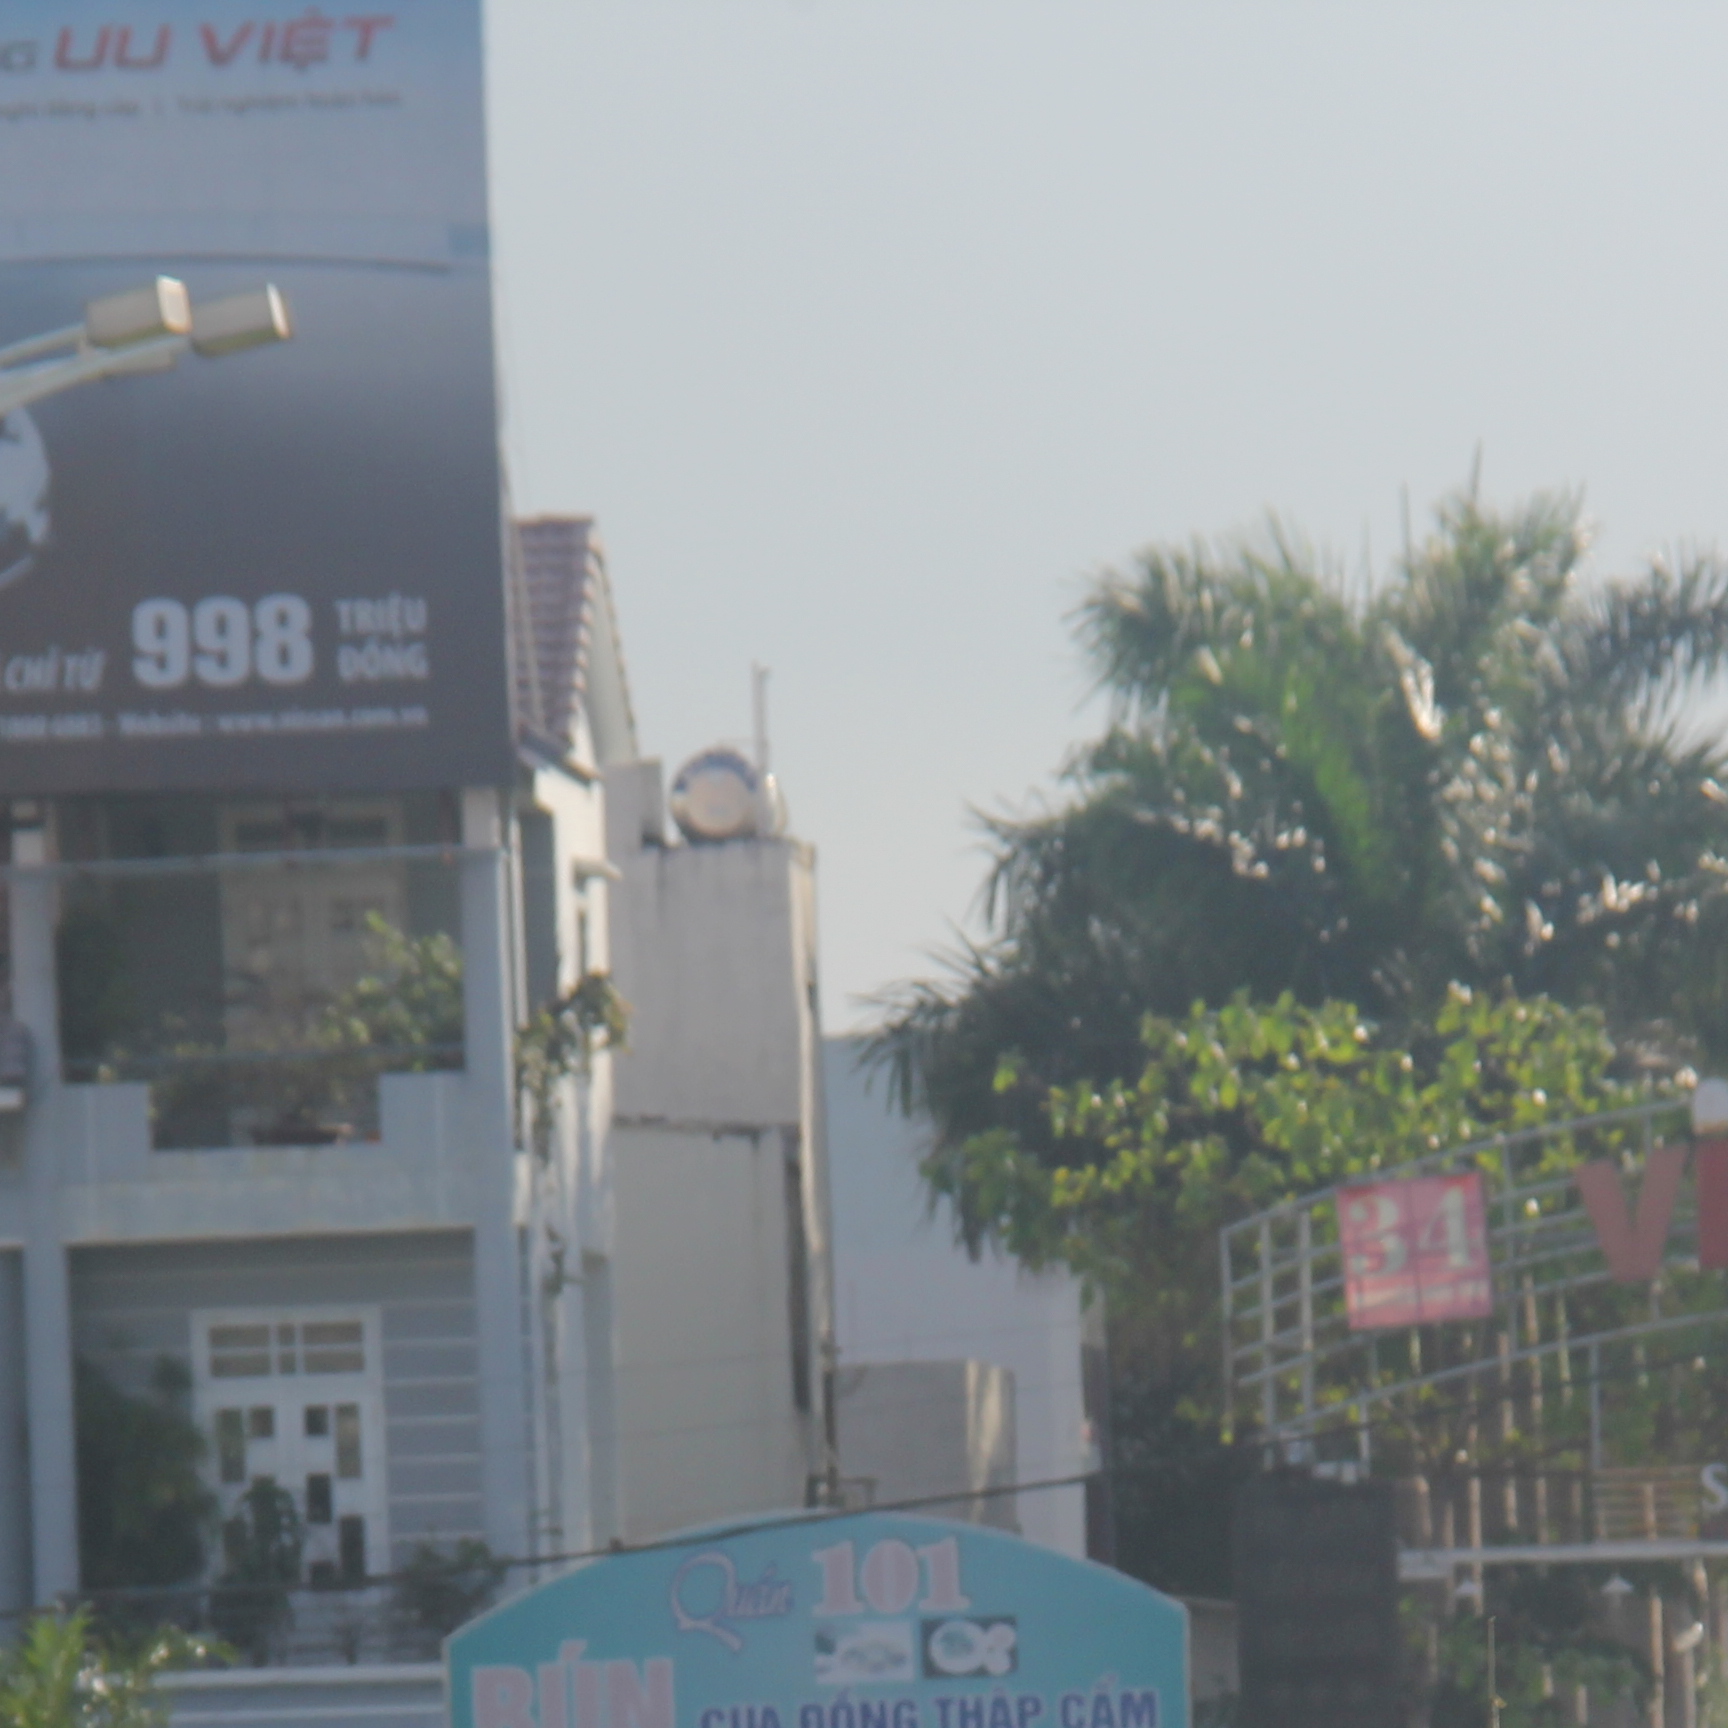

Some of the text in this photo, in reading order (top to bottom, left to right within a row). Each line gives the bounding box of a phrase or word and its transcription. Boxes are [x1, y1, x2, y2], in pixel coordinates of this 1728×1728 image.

[198, 6, 396, 72] VIỆT
[132, 593, 313, 688] 998
[1348, 1187, 1483, 1277] 34
[813, 1536, 971, 1617] 101
